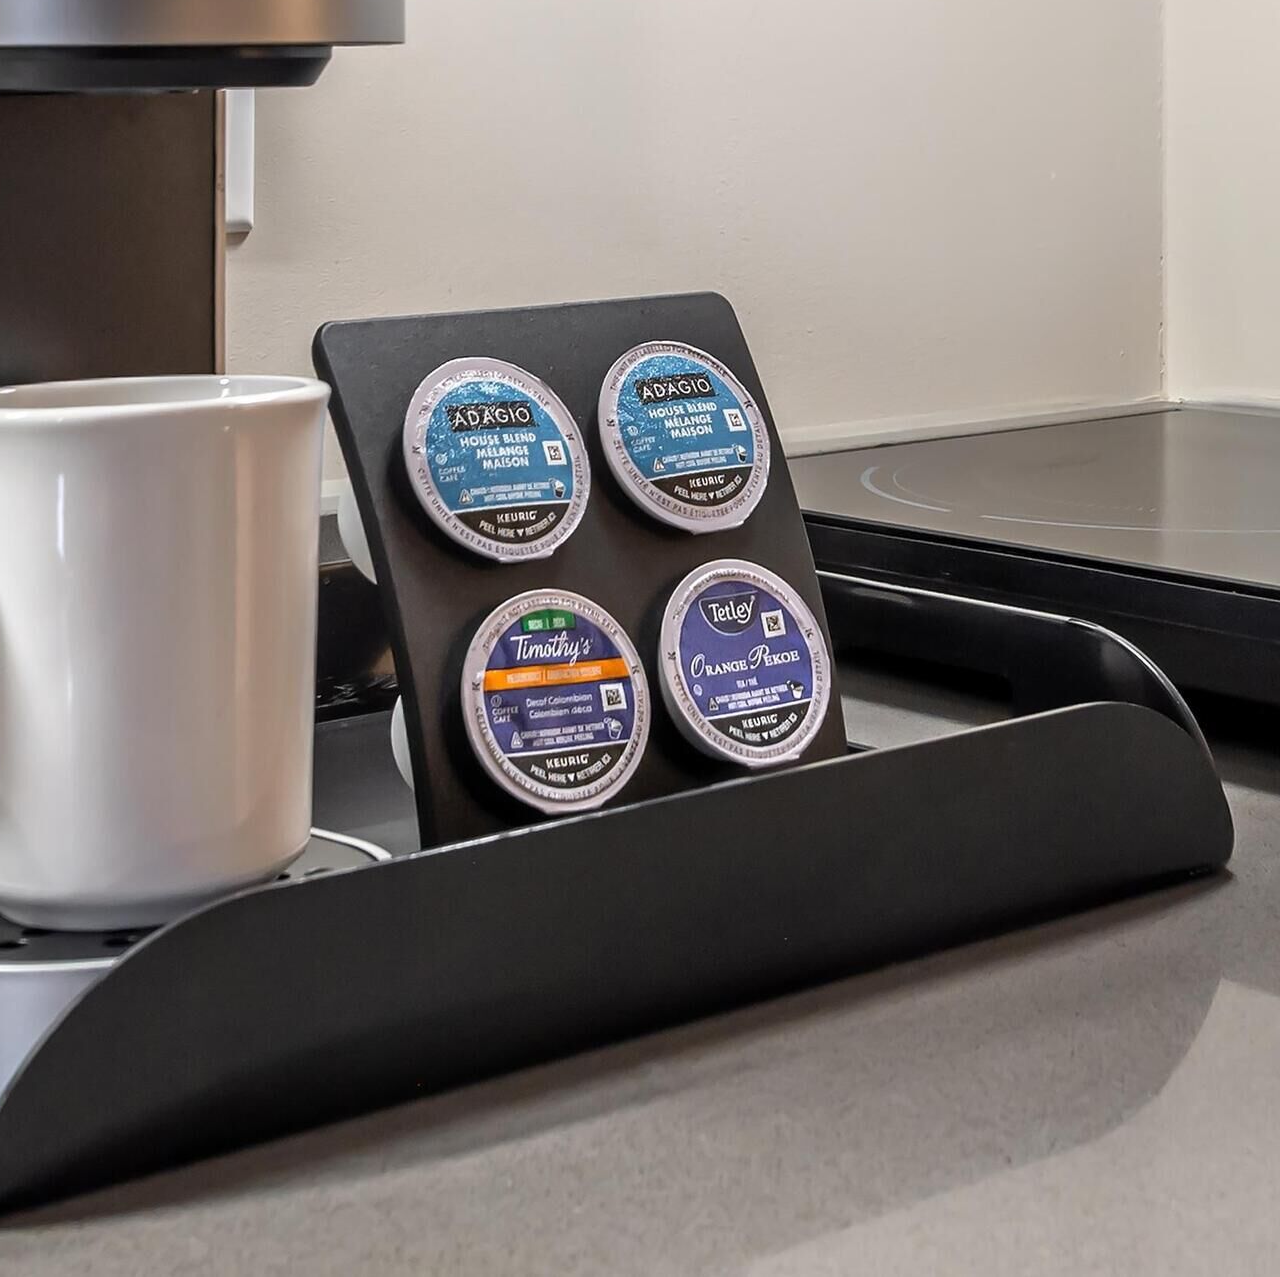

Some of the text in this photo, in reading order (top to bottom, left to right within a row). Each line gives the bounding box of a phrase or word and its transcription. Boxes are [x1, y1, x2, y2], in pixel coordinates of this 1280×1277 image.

[643, 378, 710, 399] ADAGIO
[453, 406, 530, 428] ADAGIO
[649, 402, 717, 419] HOUSE BLEND
[671, 424, 713, 439] MAISON
[460, 433, 536, 447] HOUSE BLEND
[483, 457, 529, 470] MAISON
[689, 474, 725, 488] KEURIG
[674, 485, 690, 498] PEEL
[690, 492, 708, 501] HERE
[496, 510, 538, 524] KEURIG
[479, 520, 496, 534] PEEL
[497, 527, 515, 538] HERE
[708, 595, 755, 624] Tetley
[510, 630, 592, 667] Timothy's
[691, 643, 800, 678] ORANGE PEKOE
[526, 693, 593, 708] Decaf Colombian
[741, 714, 778, 728] KEURIG
[729, 725, 746, 739] PEEL
[546, 753, 589, 769] KEURIG
[530, 764, 547, 780] PEEL
[548, 772, 567, 783] HERE
